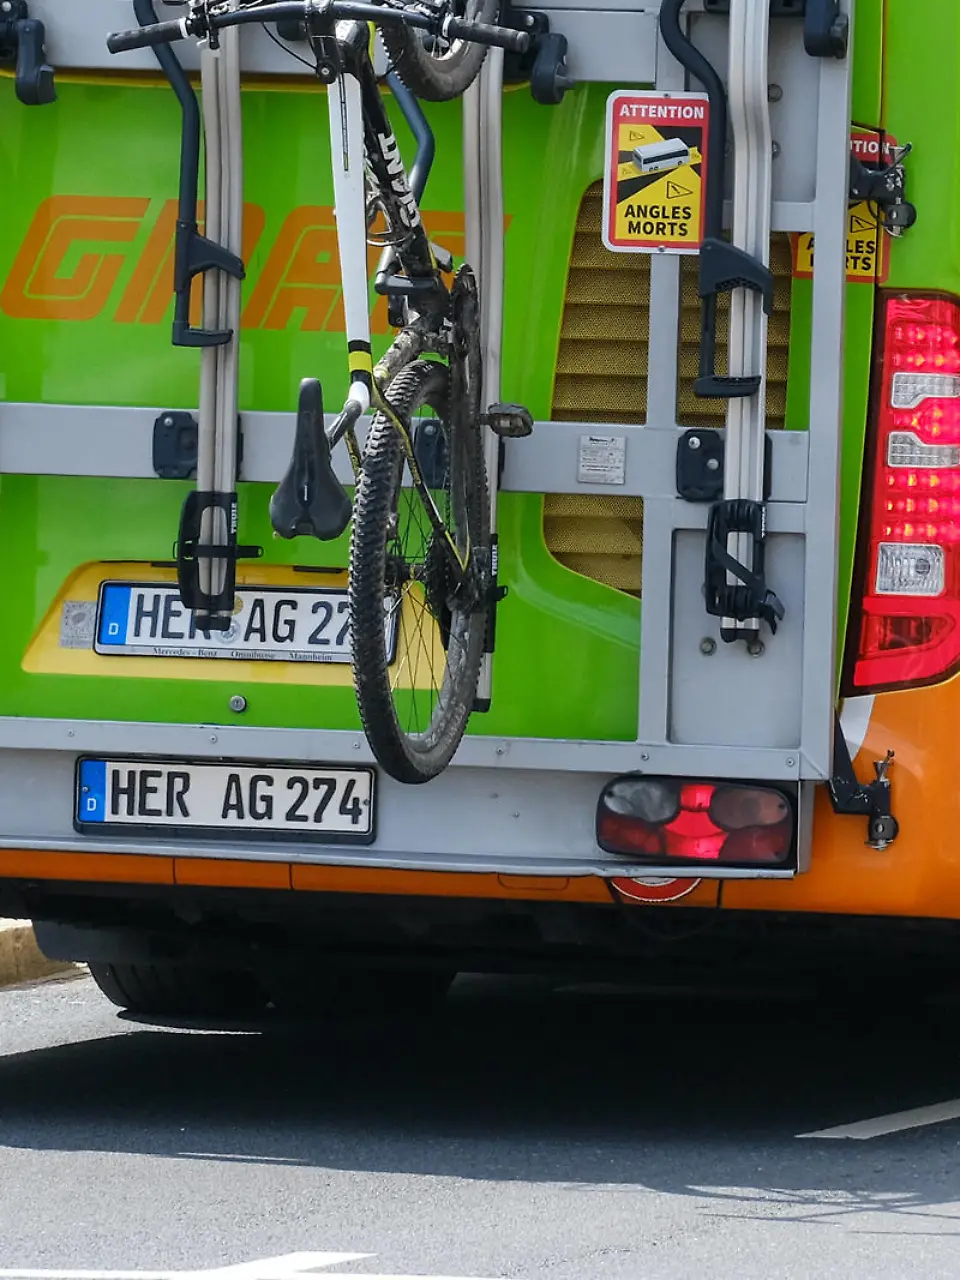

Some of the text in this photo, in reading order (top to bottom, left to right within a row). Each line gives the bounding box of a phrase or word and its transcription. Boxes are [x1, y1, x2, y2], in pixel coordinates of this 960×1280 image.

[619, 104, 705, 119] ATTENTION
[624, 204, 692, 220] ANGLES
[627, 221, 688, 236] MORTS
[244, 598, 299, 643] AG
[307, 600, 352, 646] 27
[86, 769, 362, 825] D HER AG 274
